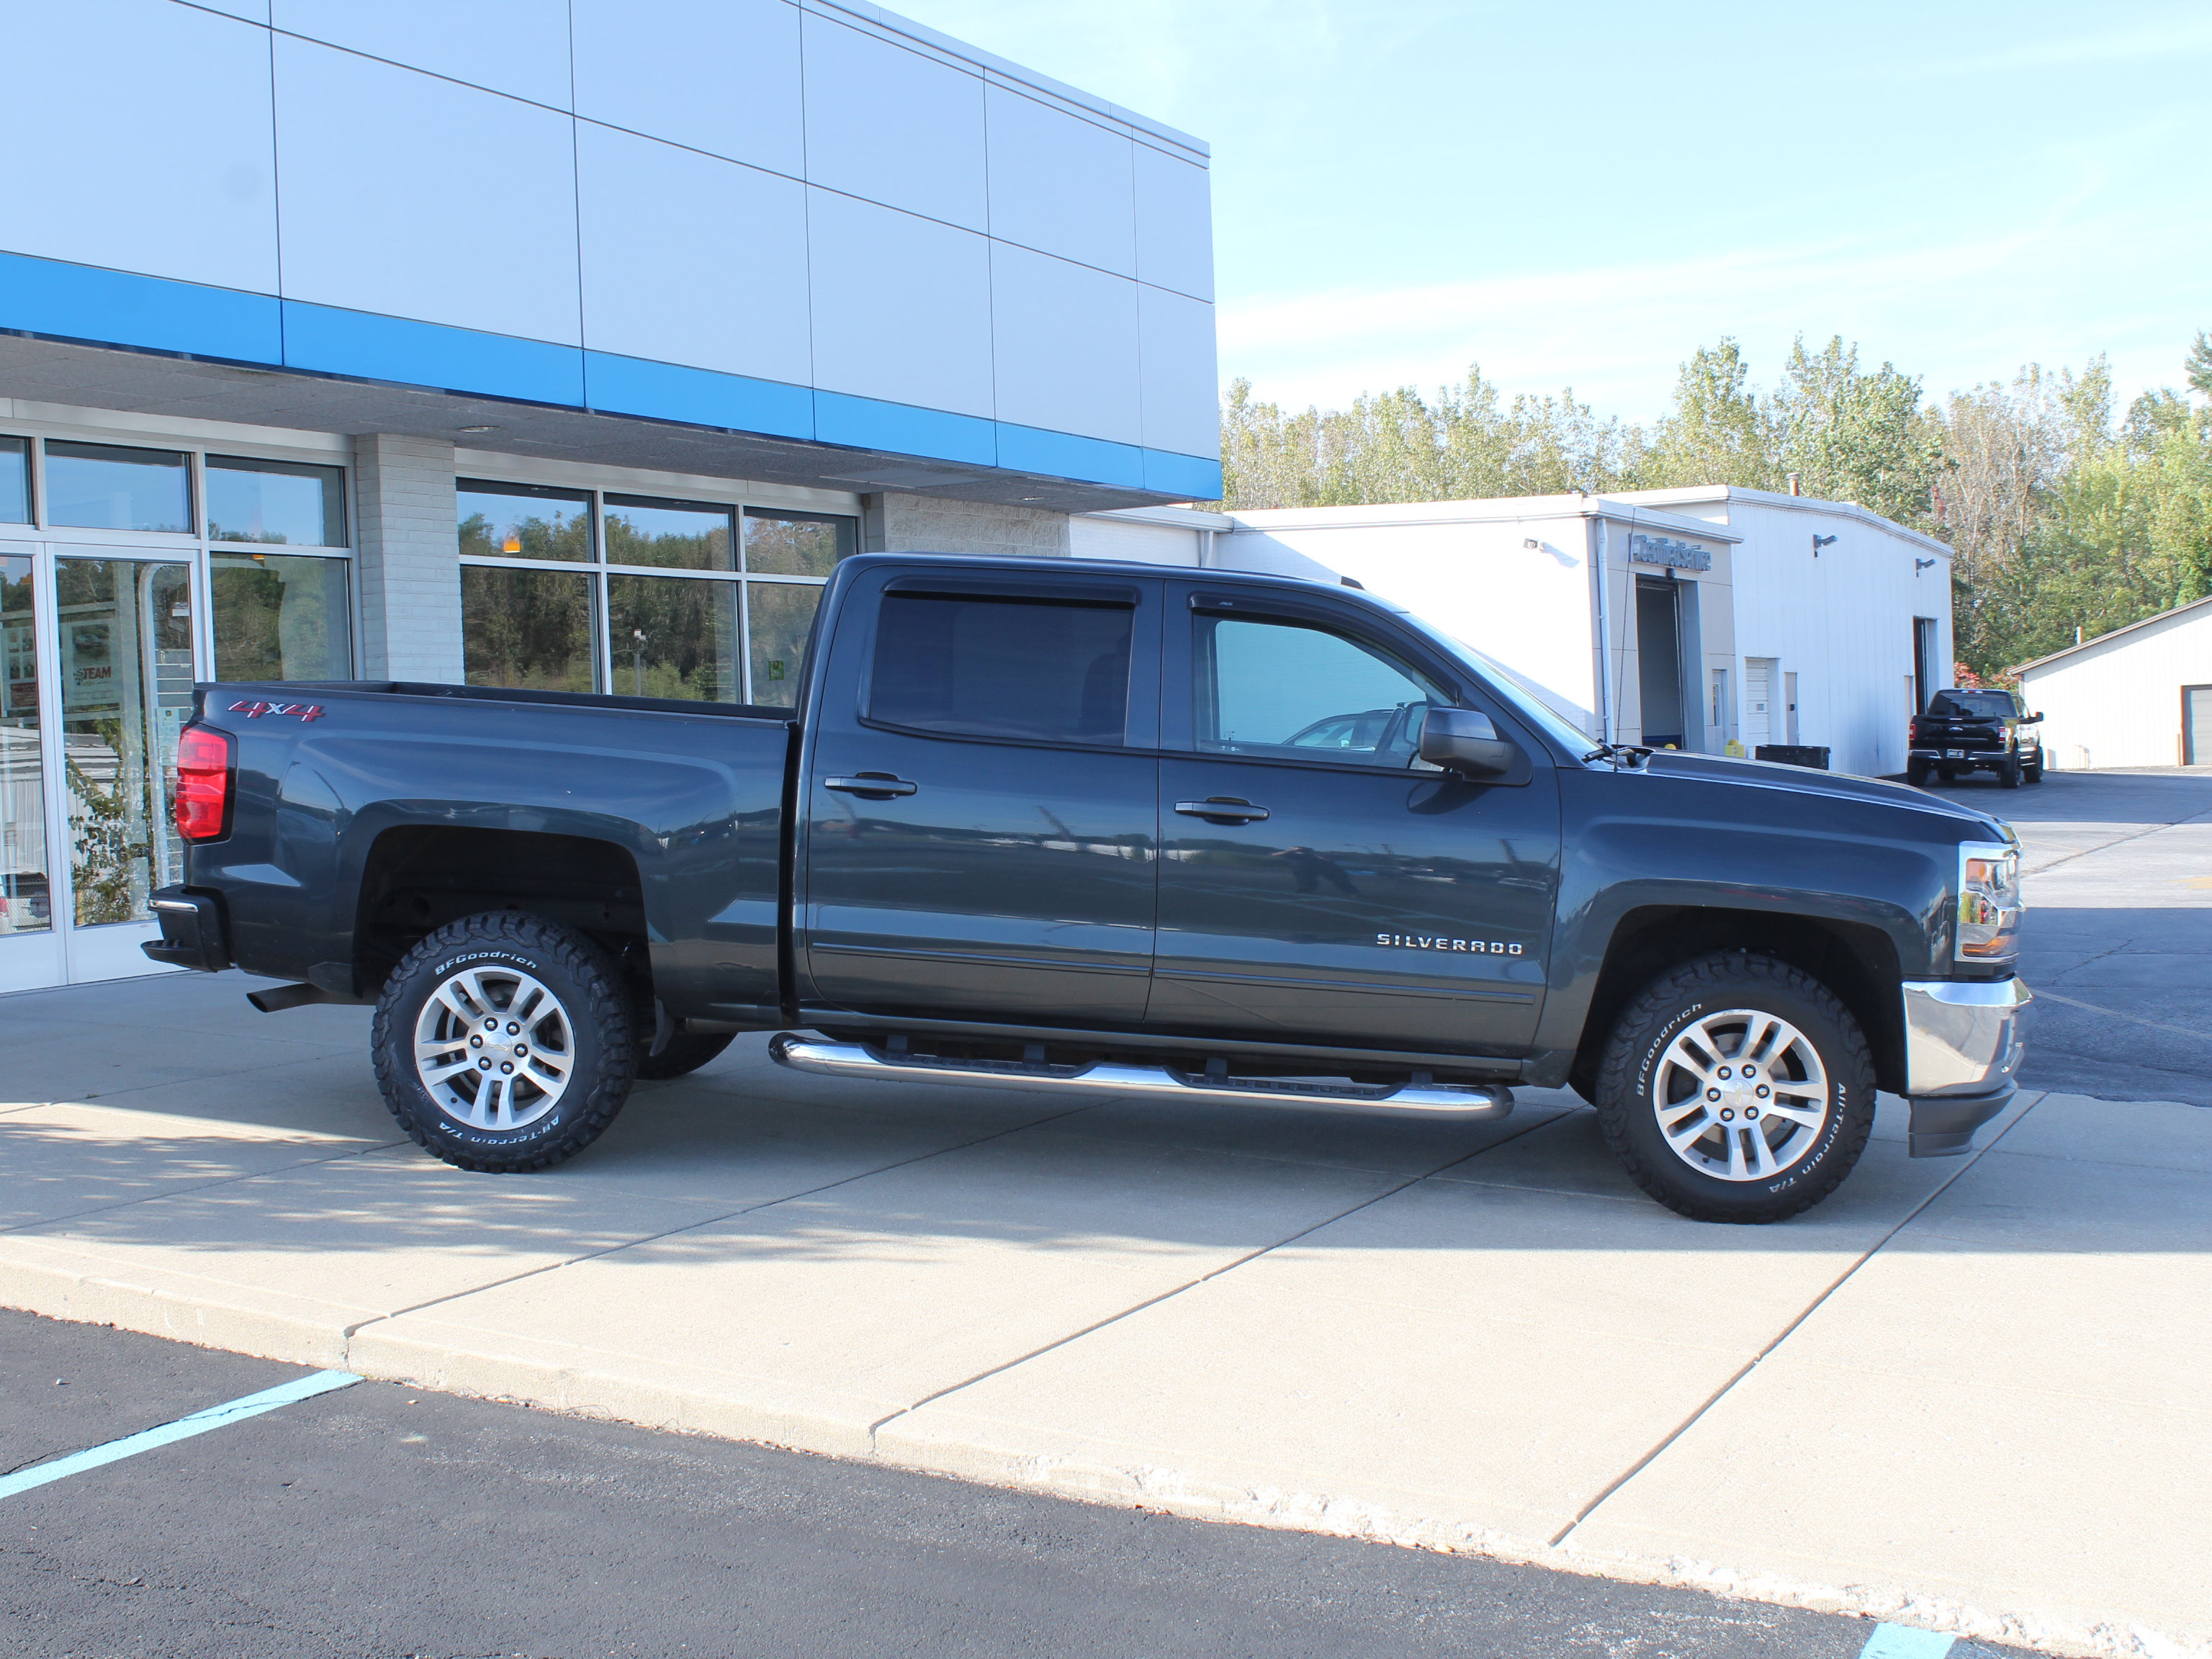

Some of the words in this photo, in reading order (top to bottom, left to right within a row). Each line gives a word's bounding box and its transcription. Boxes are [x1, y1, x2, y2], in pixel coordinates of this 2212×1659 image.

[82, 666, 112, 680] TEAM
[1376, 933, 1516, 956] SILVERADO
[435, 950, 537, 976] BFGoodrich
[1636, 1002, 1702, 1097] BFGoodrich
[439, 1121, 463, 1140] T/A
[1768, 1177, 1798, 1193] T/A
